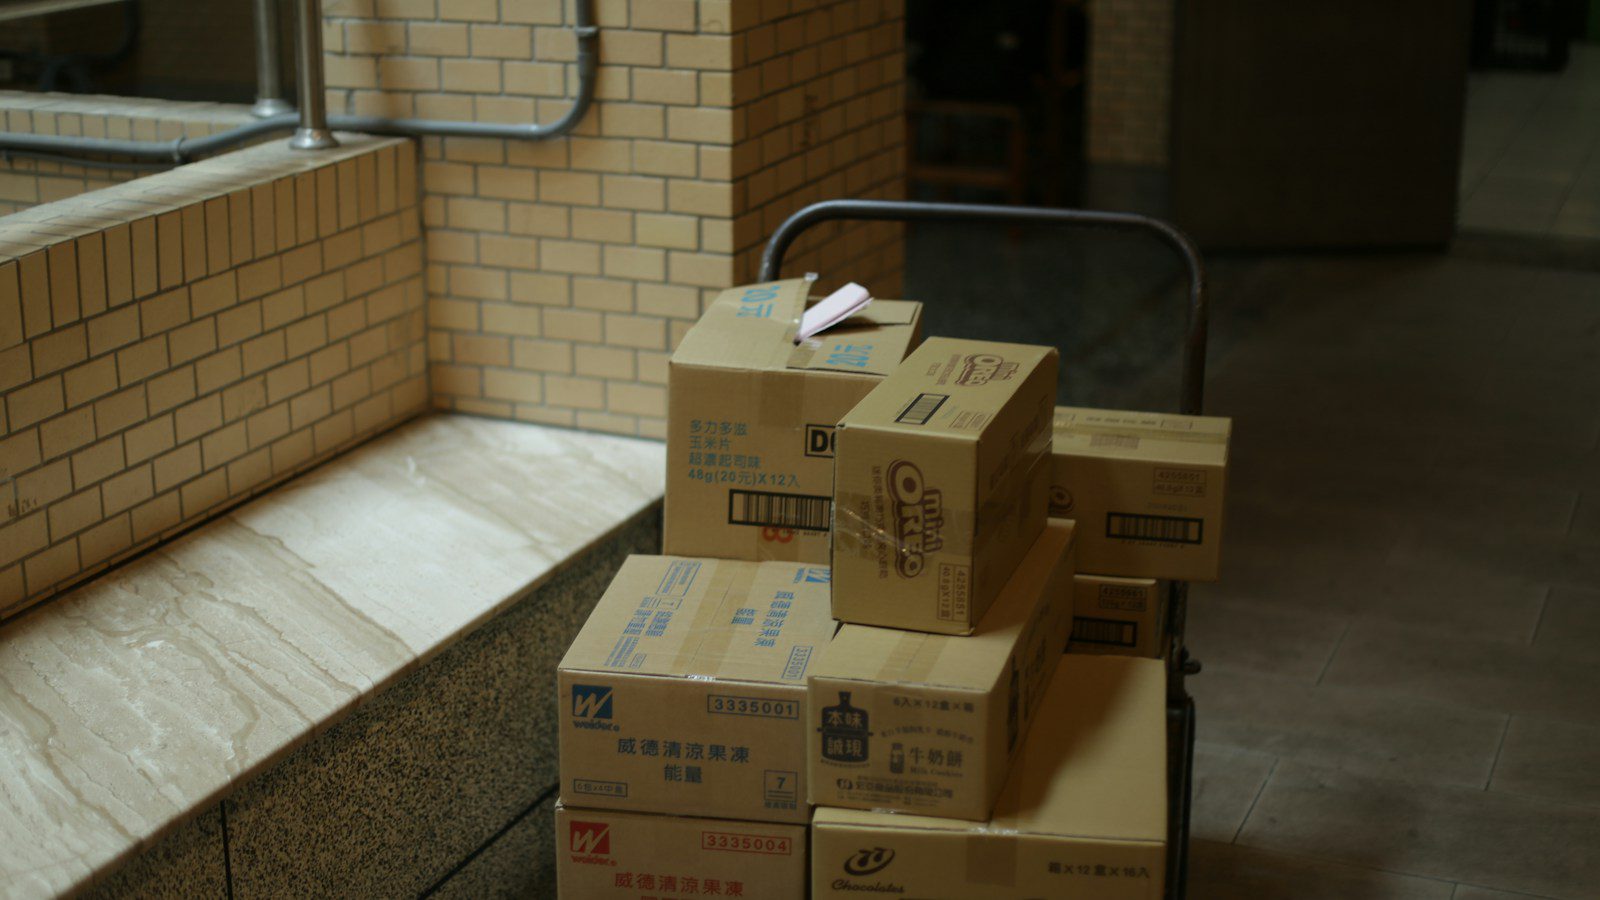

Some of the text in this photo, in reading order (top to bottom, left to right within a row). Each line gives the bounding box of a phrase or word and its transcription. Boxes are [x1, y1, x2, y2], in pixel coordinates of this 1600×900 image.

[689, 420, 749, 437] 多力多滋
[689, 435, 732, 451] 玉米片
[810, 429, 835, 453] D
[886, 458, 925, 579] OREO
[714, 698, 793, 716] 3335001
[828, 711, 863, 728] 本味
[617, 737, 750, 764] 威德清涼果凍
[909, 746, 963, 768] 牛奶餅
[663, 764, 703, 784] 能量
[776, 776, 787, 791] 7
[707, 834, 787, 852] 3335004
[614, 871, 744, 897] 威德清涼果凍
